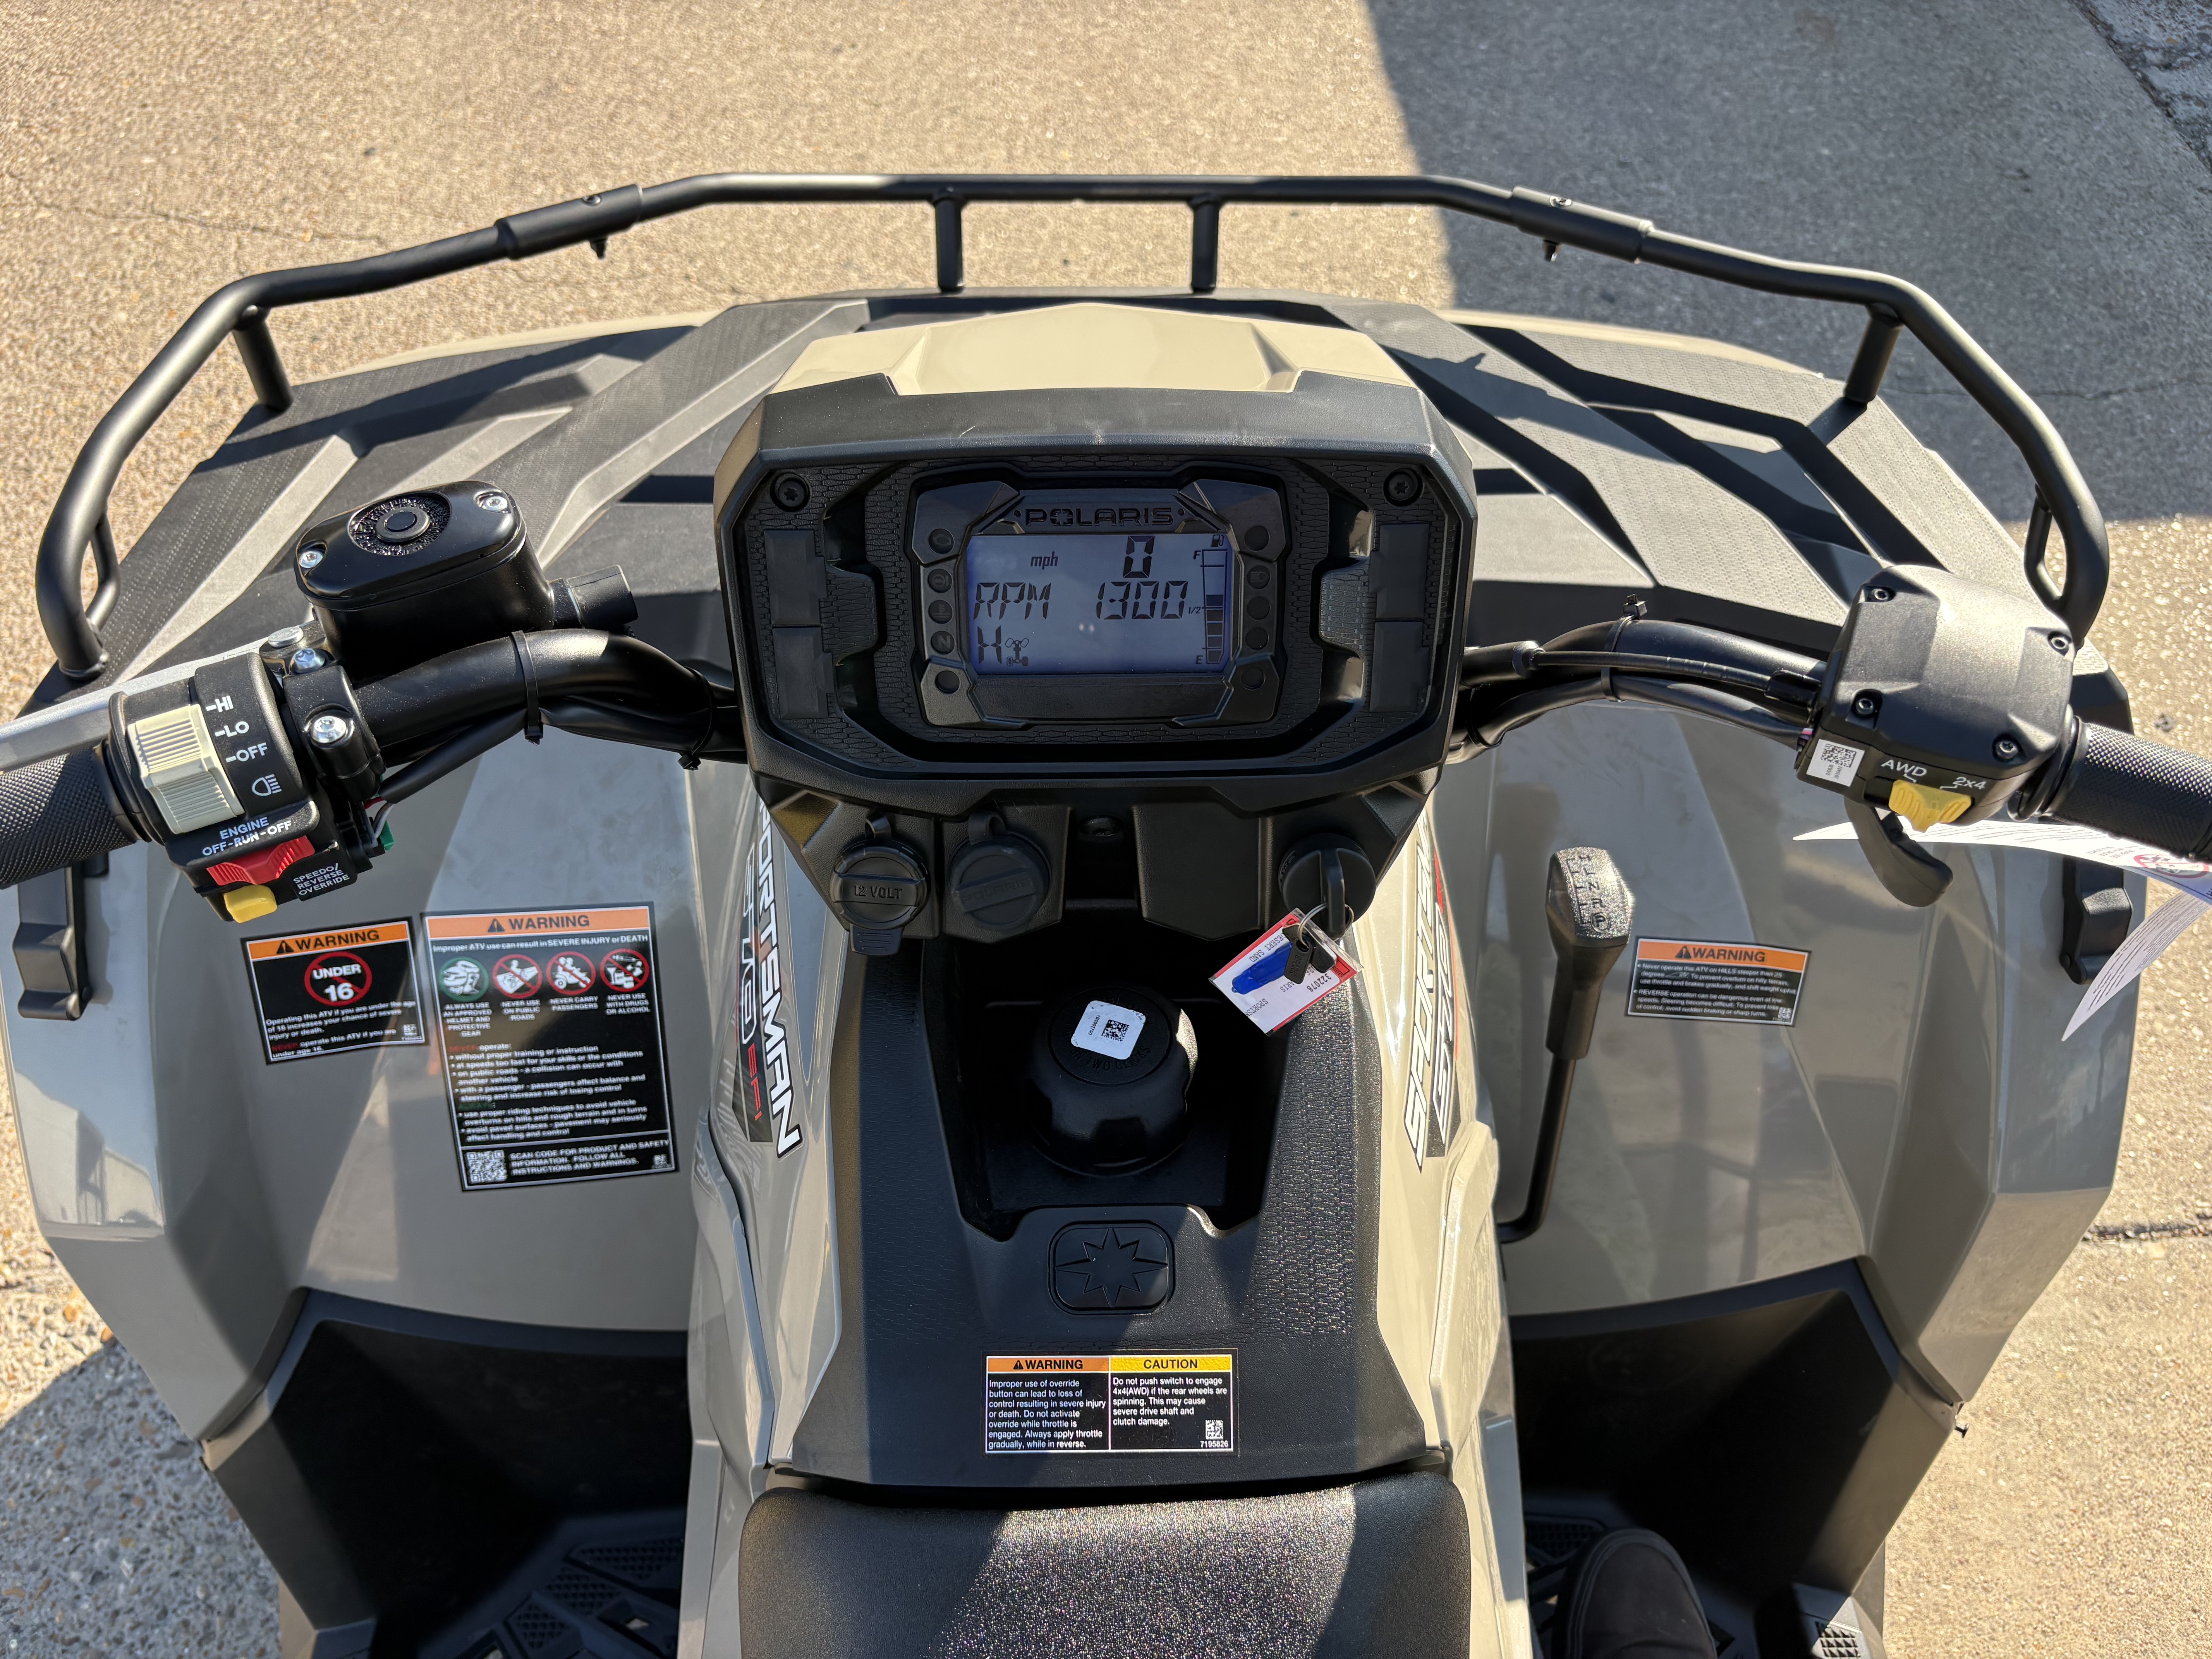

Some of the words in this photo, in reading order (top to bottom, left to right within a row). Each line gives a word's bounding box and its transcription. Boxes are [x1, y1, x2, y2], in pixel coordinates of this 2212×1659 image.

[1025, 508, 1173, 527] POLARIS
[1030, 551, 1058, 569] mph
[1123, 535, 1155, 578] 0
[1193, 550, 1201, 560] F
[974, 582, 1051, 619] RPM
[1096, 581, 1188, 619] 1300
[1196, 655, 1203, 664] E
[1881, 759, 1927, 776] AWD
[219, 817, 270, 840] ENGINE
[294, 863, 339, 883] SPEEDO/
[297, 869, 344, 889] REVERSE
[299, 874, 350, 896] OVERRIDE
[854, 885, 866, 897] 12
[870, 886, 902, 899] VOLT
[508, 914, 589, 930] WARNING
[295, 929, 379, 950] WARNING
[741, 841, 757, 1044] 570
[1265, 933, 1287, 951] DESERT
[1249, 949, 1265, 962] SAND
[1692, 947, 1765, 962] WARNING
[313, 963, 361, 979] UNDER
[1307, 974, 1332, 992] 322078
[325, 982, 354, 1001] 16
[747, 1042, 763, 1121] EFI
[1025, 1359, 1083, 1369] WARNING
[1144, 1359, 1197, 1369] CAUTION
[989, 1379, 1023, 1389] Improper
[1040, 1379, 1047, 1387] of
[1113, 1377, 1123, 1386] Do
[1140, 1377, 1158, 1386] push
[1159, 1376, 1183, 1384] switch
[1195, 1378, 1222, 1386] engage
[1030, 1389, 1046, 1397] lead
[1113, 1387, 1149, 1396] 4x4(AWD)
[1151, 1386, 1156, 1395] if
[1188, 1386, 1214, 1395] wheels
[1017, 1400, 1048, 1409] resulting
[1085, 1399, 1106, 1409] injury
[1113, 1397, 1146, 1407] spinning.
[1148, 1397, 1164, 1405] This
[1166, 1398, 1182, 1406] may
[1024, 1409, 1034, 1417] Do
[1050, 1409, 1080, 1417] activate
[1139, 1407, 1158, 1415] drive
[1159, 1407, 1178, 1415] shaft
[1180, 1407, 1194, 1415] and
[988, 1420, 1018, 1428] override
[1070, 1419, 1077, 1427] is
[1113, 1417, 1135, 1425] clutch
[1137, 1417, 1170, 1427] damage.
[988, 1430, 1022, 1439] engaged.
[1025, 1429, 1051, 1439] Always
[1053, 1429, 1074, 1439] apply
[1075, 1429, 1103, 1437] throttle
[988, 1440, 1024, 1449] gradually,
[1026, 1440, 1046, 1448] while
[1200, 1440, 1228, 1448] 7195826
